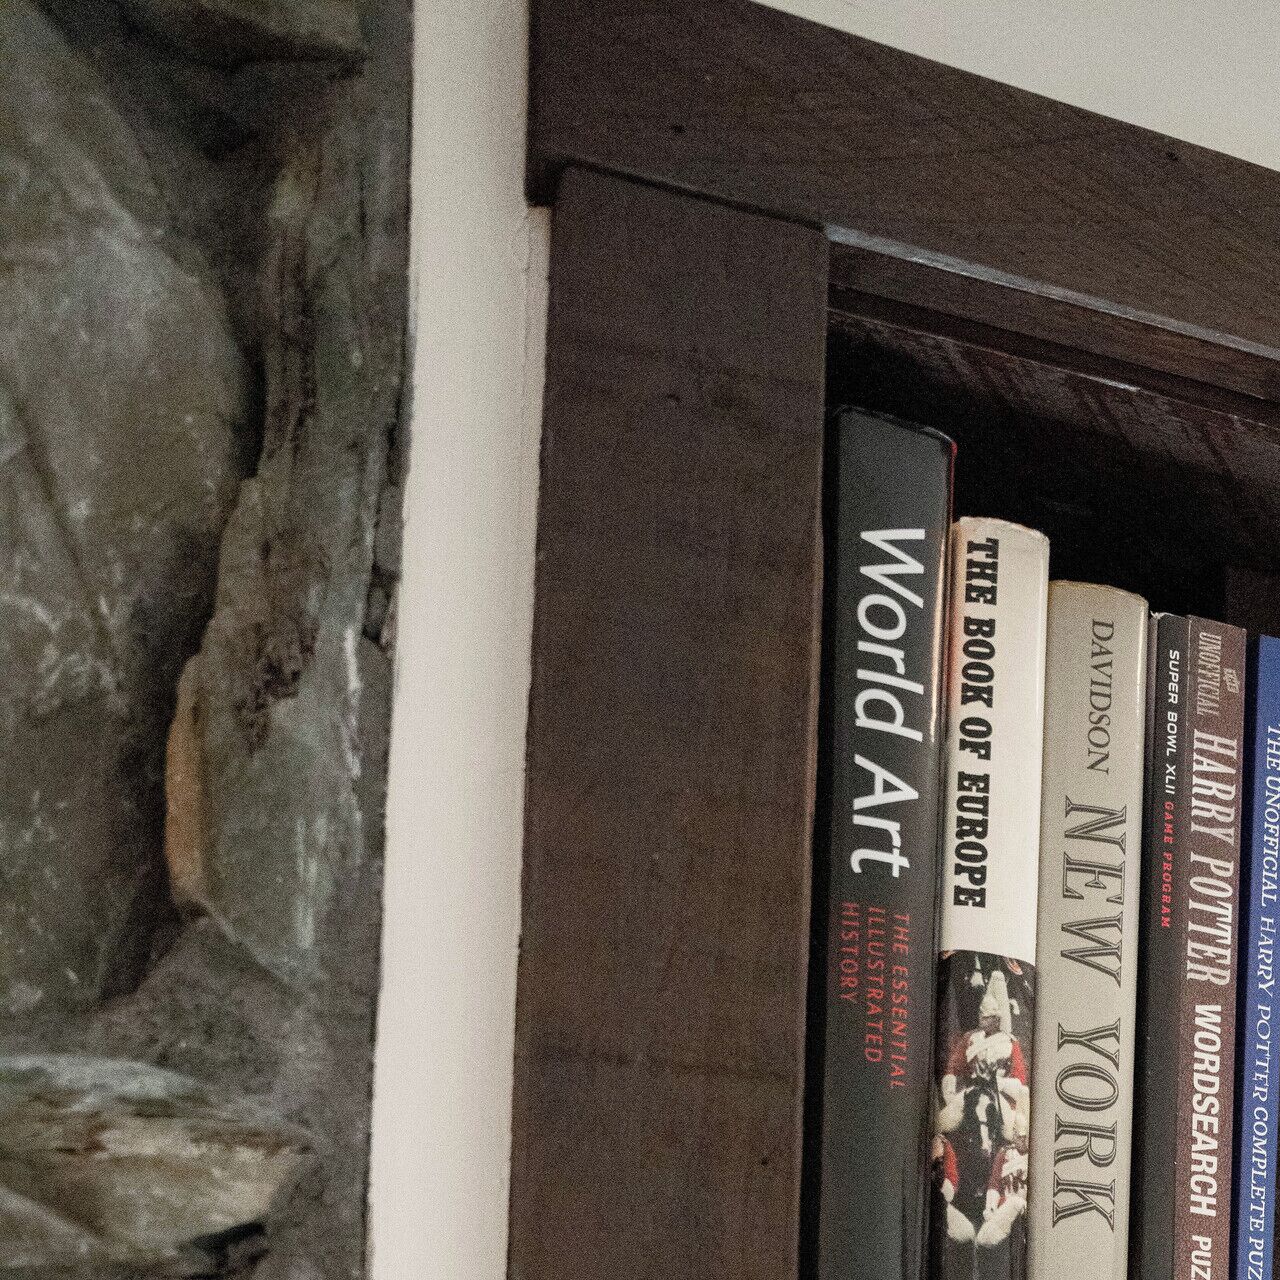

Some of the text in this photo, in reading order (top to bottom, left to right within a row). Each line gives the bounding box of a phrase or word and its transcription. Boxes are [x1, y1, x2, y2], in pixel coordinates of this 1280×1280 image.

[850, 528, 925, 876] World Art
[953, 538, 1000, 908] THE BOOK OF EUROPE
[1086, 619, 1115, 775] DAVIDSON
[1197, 632, 1222, 715] UNOFFICIAL
[1161, 649, 1180, 928] SUPER BOWL XLII GAME PROGRAM
[1190, 729, 1237, 842] HARRY
[1261, 774, 1280, 907] UNOFFICIAL
[840, 902, 860, 1002] HISTORY
[865, 907, 885, 1063] ILLUSTRATED
[1186, 850, 1234, 986] POTTER
[1257, 917, 1275, 996] HARRY
[890, 914, 910, 1088] THE ESSENTIAL
[1052, 796, 1127, 1232] NEW YORK
[1253, 1004, 1271, 1101] POTTER
[1190, 1005, 1221, 1217] WORDSEARCH
[1248, 1105, 1268, 1231] COMPLETE
